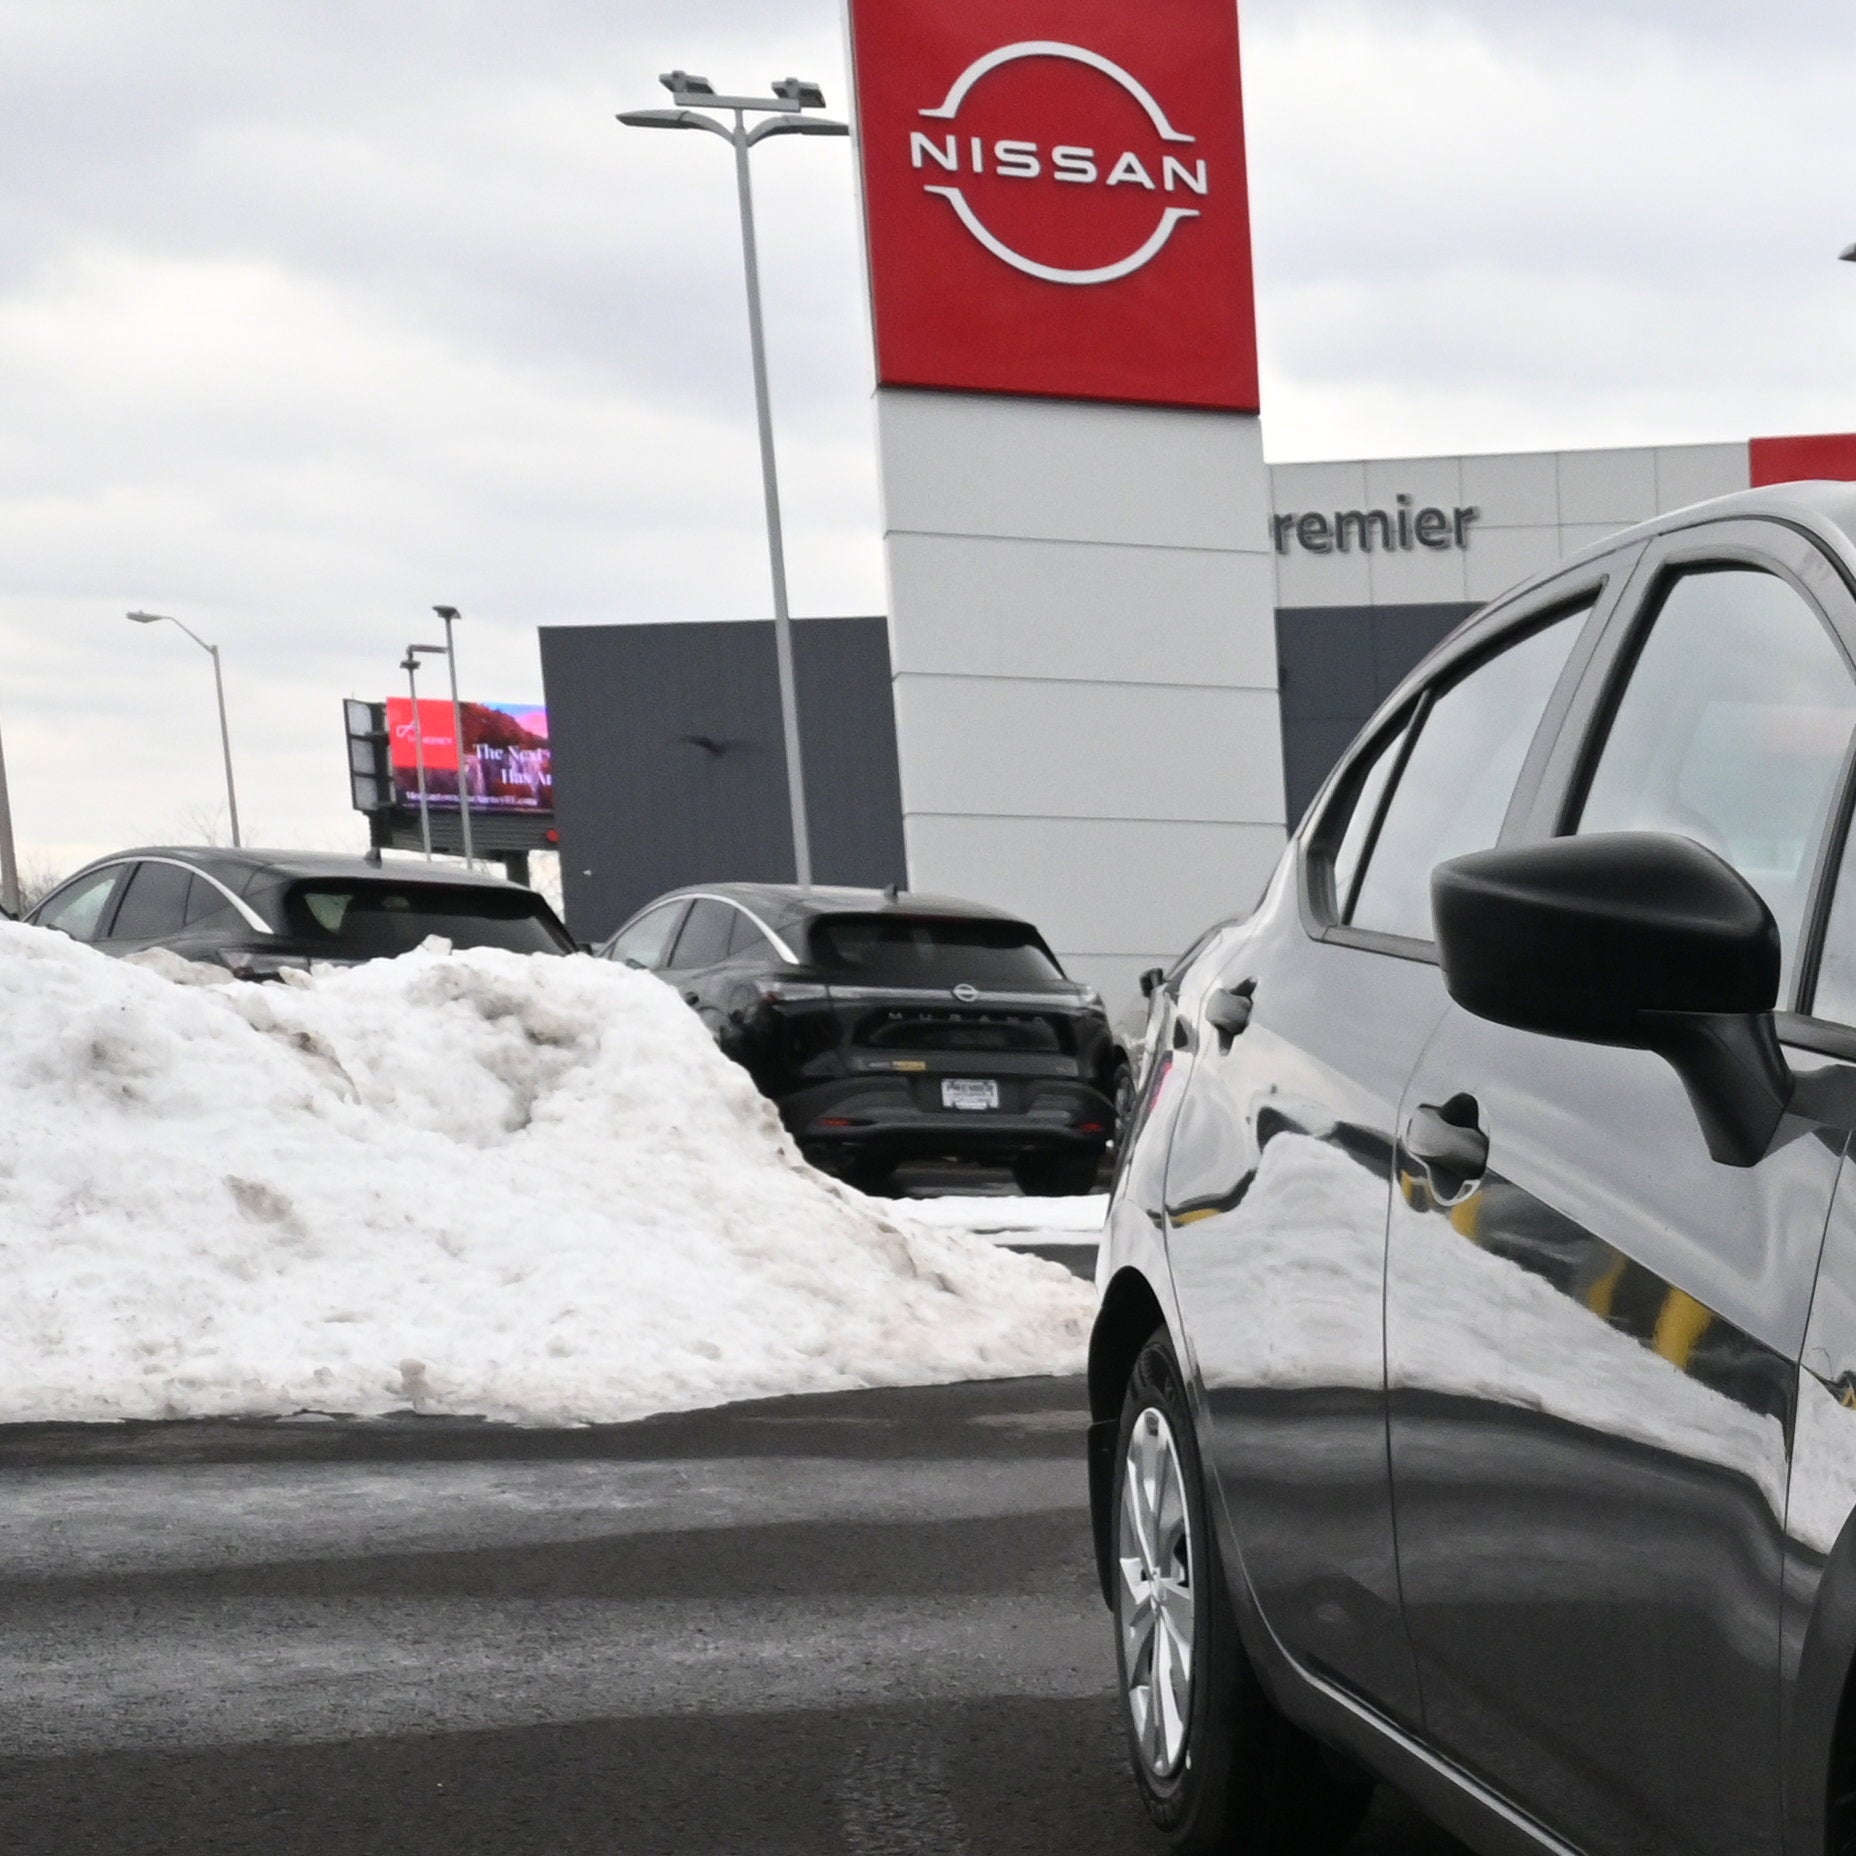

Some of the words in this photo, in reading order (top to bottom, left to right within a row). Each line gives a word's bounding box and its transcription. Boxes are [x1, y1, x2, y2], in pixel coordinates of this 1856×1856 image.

[909, 130, 1209, 195] NISSAN
[1268, 493, 1481, 555] remier
[473, 742, 504, 760] The
